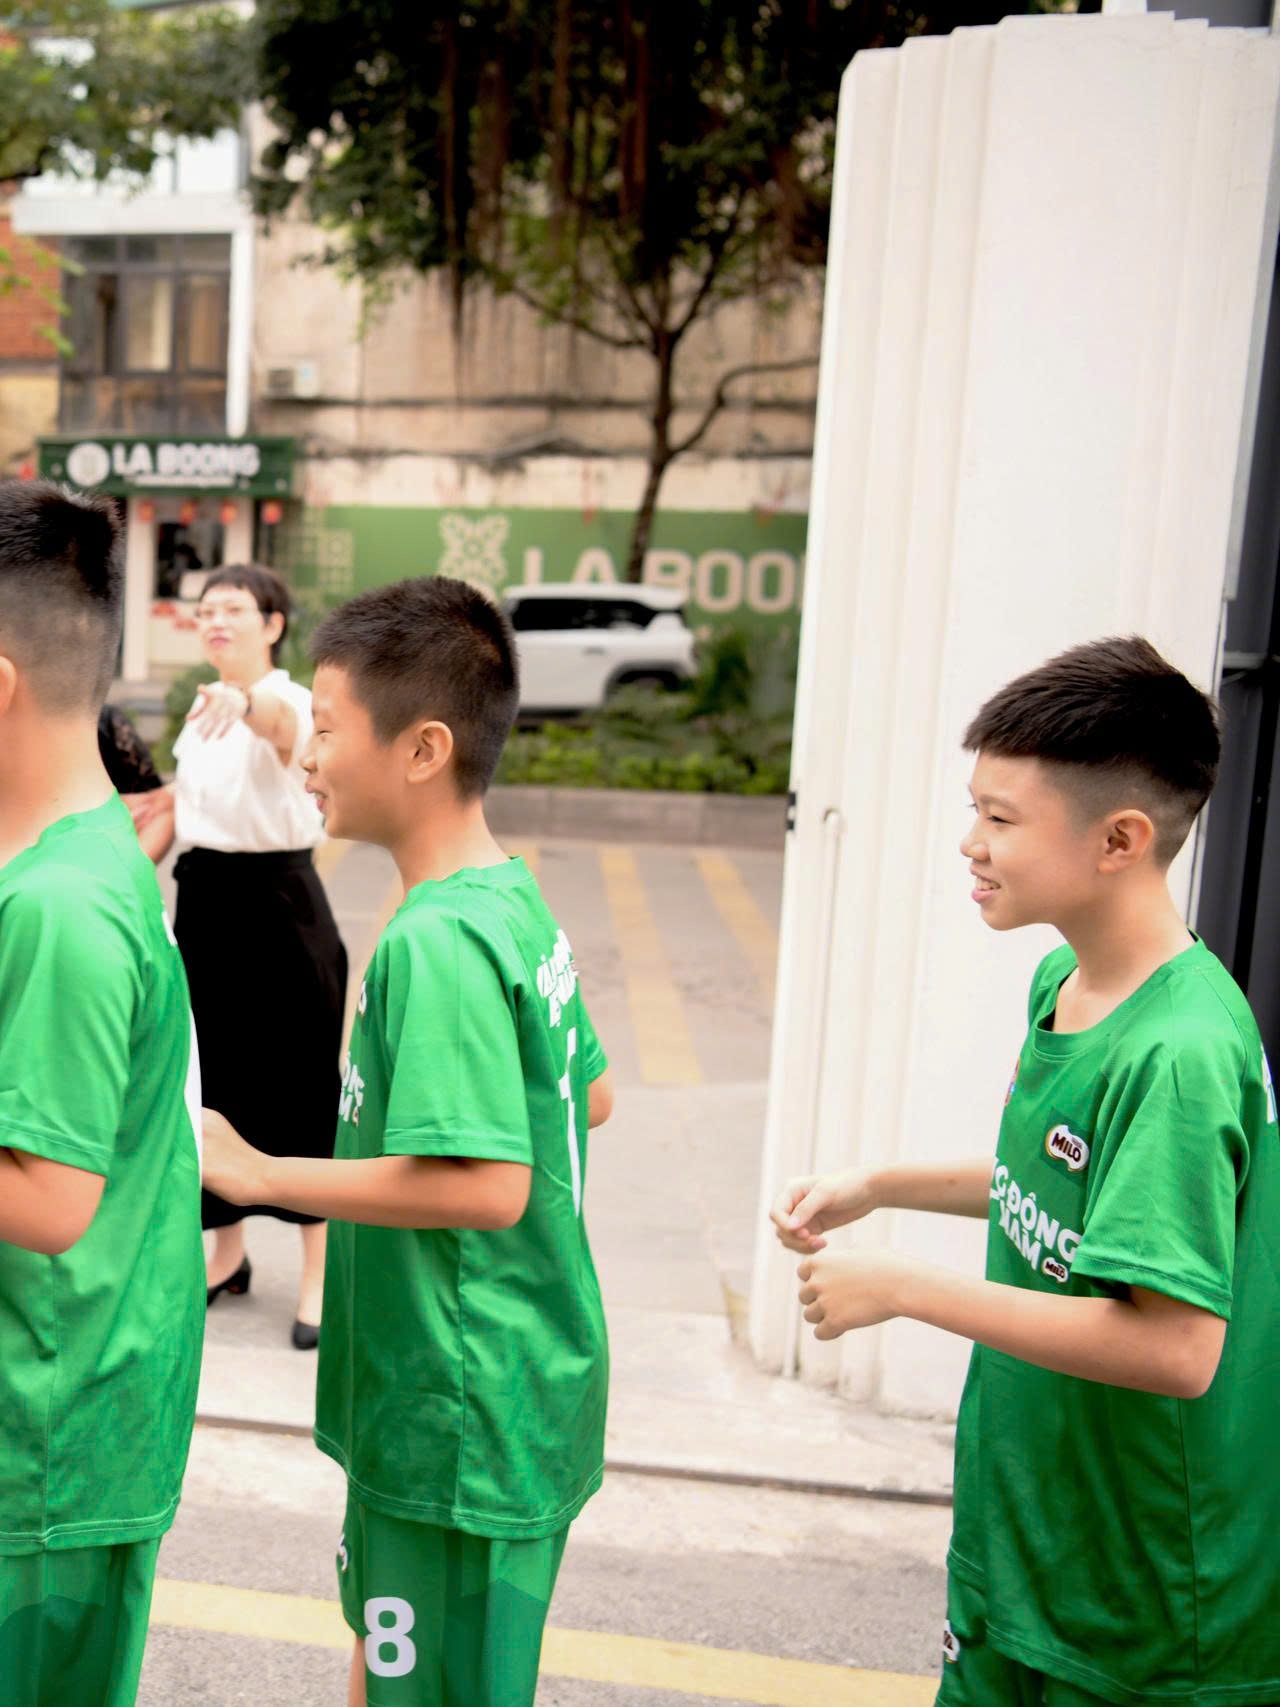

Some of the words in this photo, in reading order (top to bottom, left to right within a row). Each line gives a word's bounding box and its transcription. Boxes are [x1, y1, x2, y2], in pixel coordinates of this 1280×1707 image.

[113, 442, 152, 476] LA
[642, 548, 805, 613] BOO
[1051, 1132, 1081, 1162] MILO
[364, 1597, 416, 1677] 8
